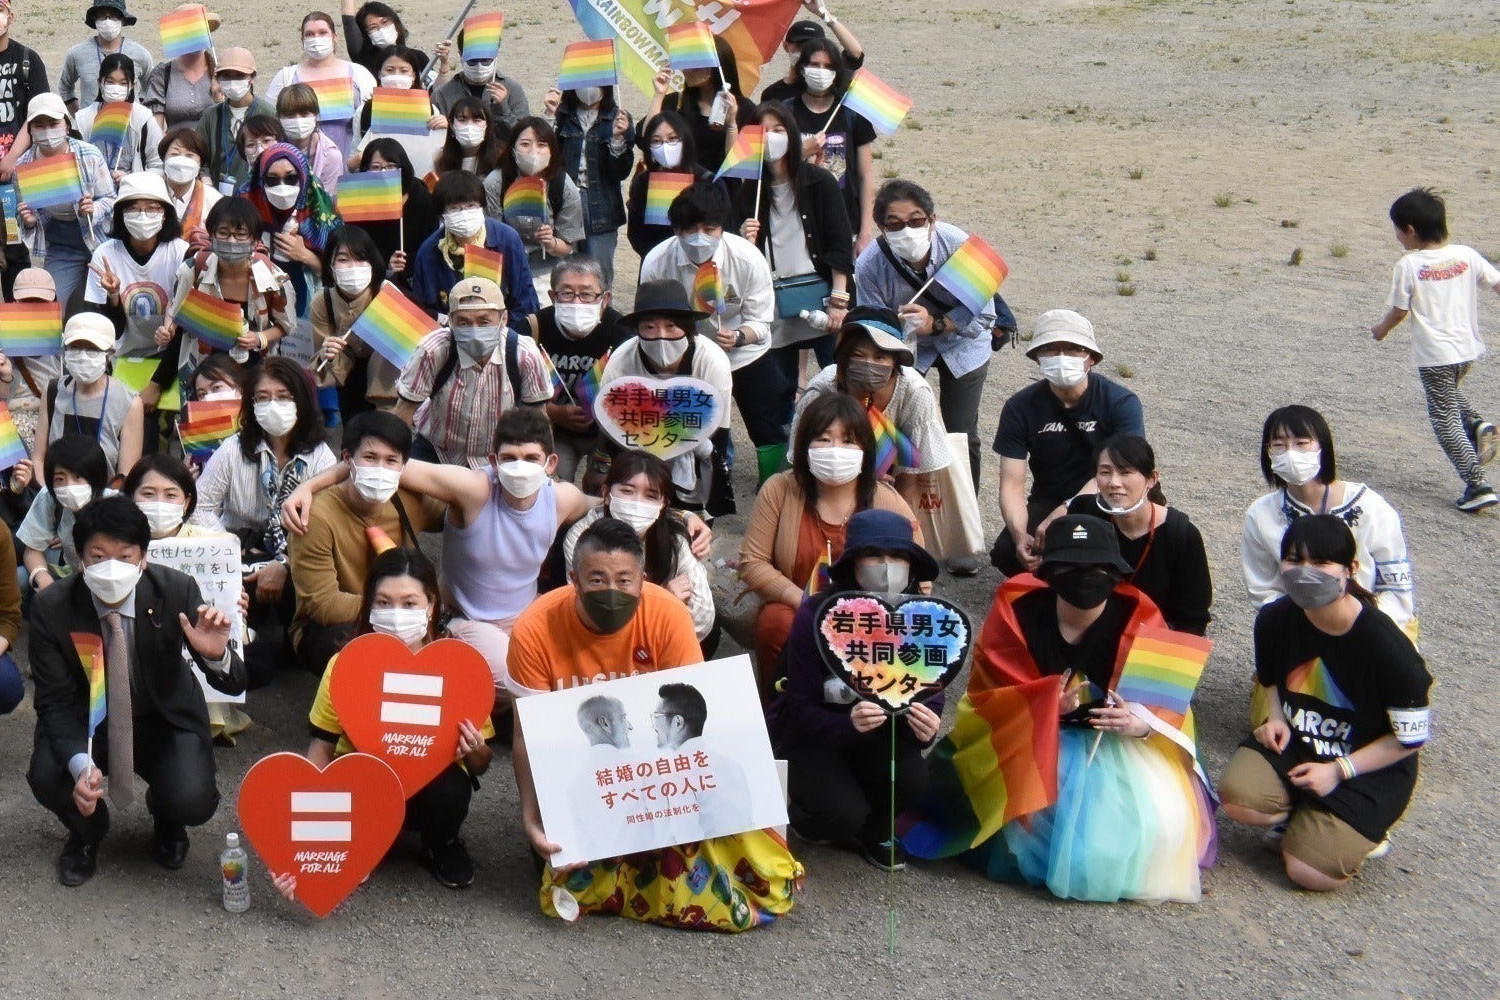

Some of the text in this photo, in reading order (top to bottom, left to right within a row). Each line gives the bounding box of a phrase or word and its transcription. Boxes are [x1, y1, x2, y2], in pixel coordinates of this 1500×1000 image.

[604, 388, 713, 408] 岩手県男女
[620, 409, 702, 429] 共同参画
[621, 430, 698, 448] センター
[832, 610, 960, 639] 岩手県男女
[845, 640, 948, 667] 共同参画
[853, 671, 941, 695] センター
[1393, 719, 1428, 733] STAFF
[381, 732, 436, 746] MARRIAGE
[386, 746, 428, 757] FOR ALL
[595, 750, 709, 787] 結婚の自由を
[601, 774, 717, 810] すべての人に
[626, 804, 700, 824] 同性婚の法制化を
[293, 851, 348, 862] MARRIAGE
[300, 863, 342, 873] FOR ALL
